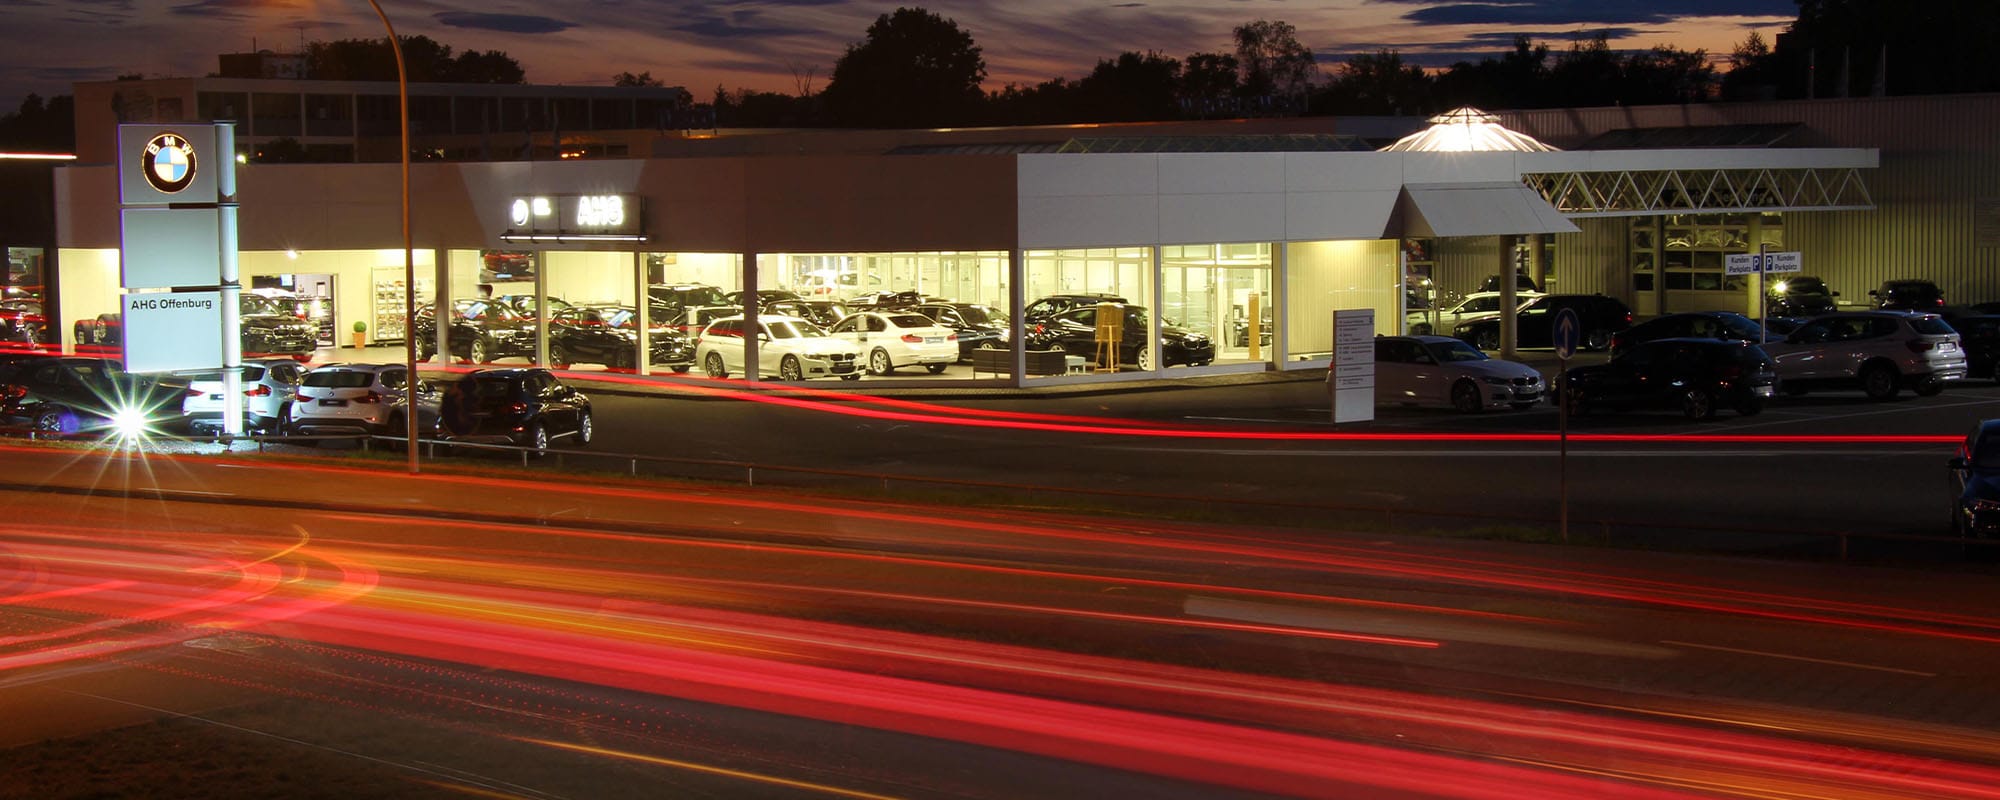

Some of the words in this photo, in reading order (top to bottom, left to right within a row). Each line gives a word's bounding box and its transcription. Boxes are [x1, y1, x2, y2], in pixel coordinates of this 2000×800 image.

[148, 136, 193, 155] BMW
[577, 195, 624, 225] AHG
[1729, 265, 1752, 273] Parkplatz
[1774, 263, 1798, 271] Parkplatz
[131, 300, 157, 310] AHG
[160, 299, 212, 310] Offenburg
